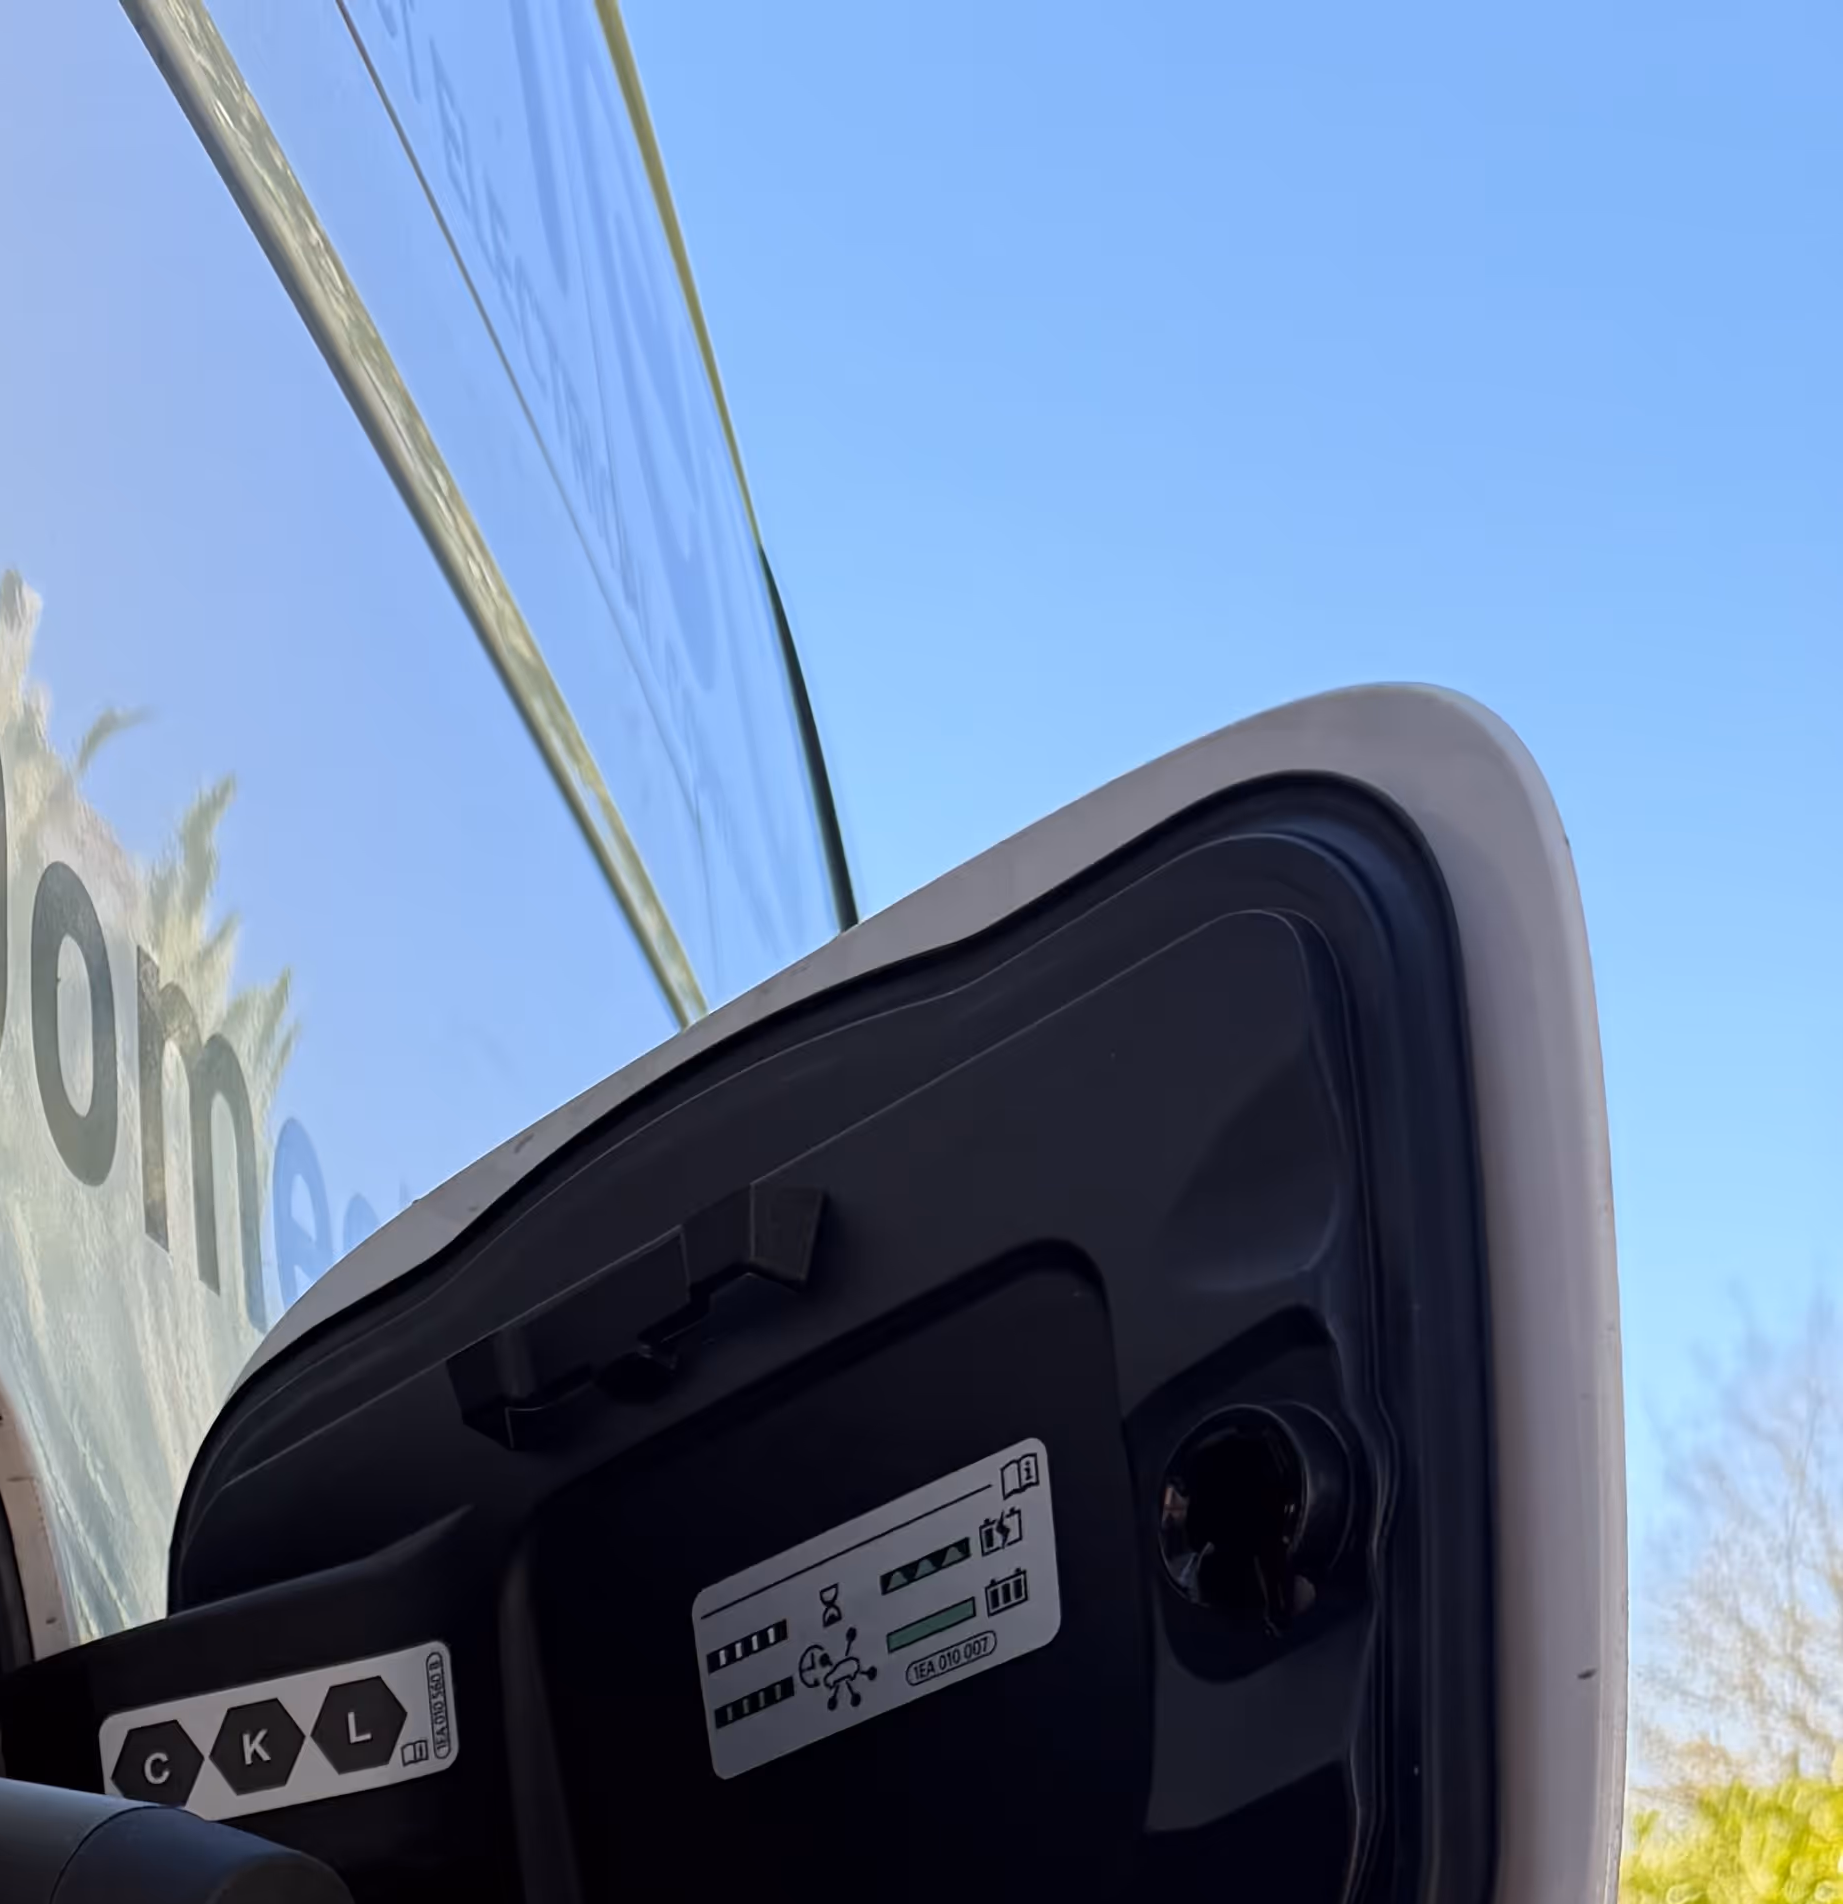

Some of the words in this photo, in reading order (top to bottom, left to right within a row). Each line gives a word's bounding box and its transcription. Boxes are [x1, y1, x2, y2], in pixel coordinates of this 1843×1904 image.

[913, 1660, 937, 1680] 1EA
[939, 1648, 962, 1670] 010
[964, 1637, 990, 1661] 007
[143, 1752, 172, 1785] C
[241, 1728, 271, 1767] K
[347, 1711, 371, 1744] L
